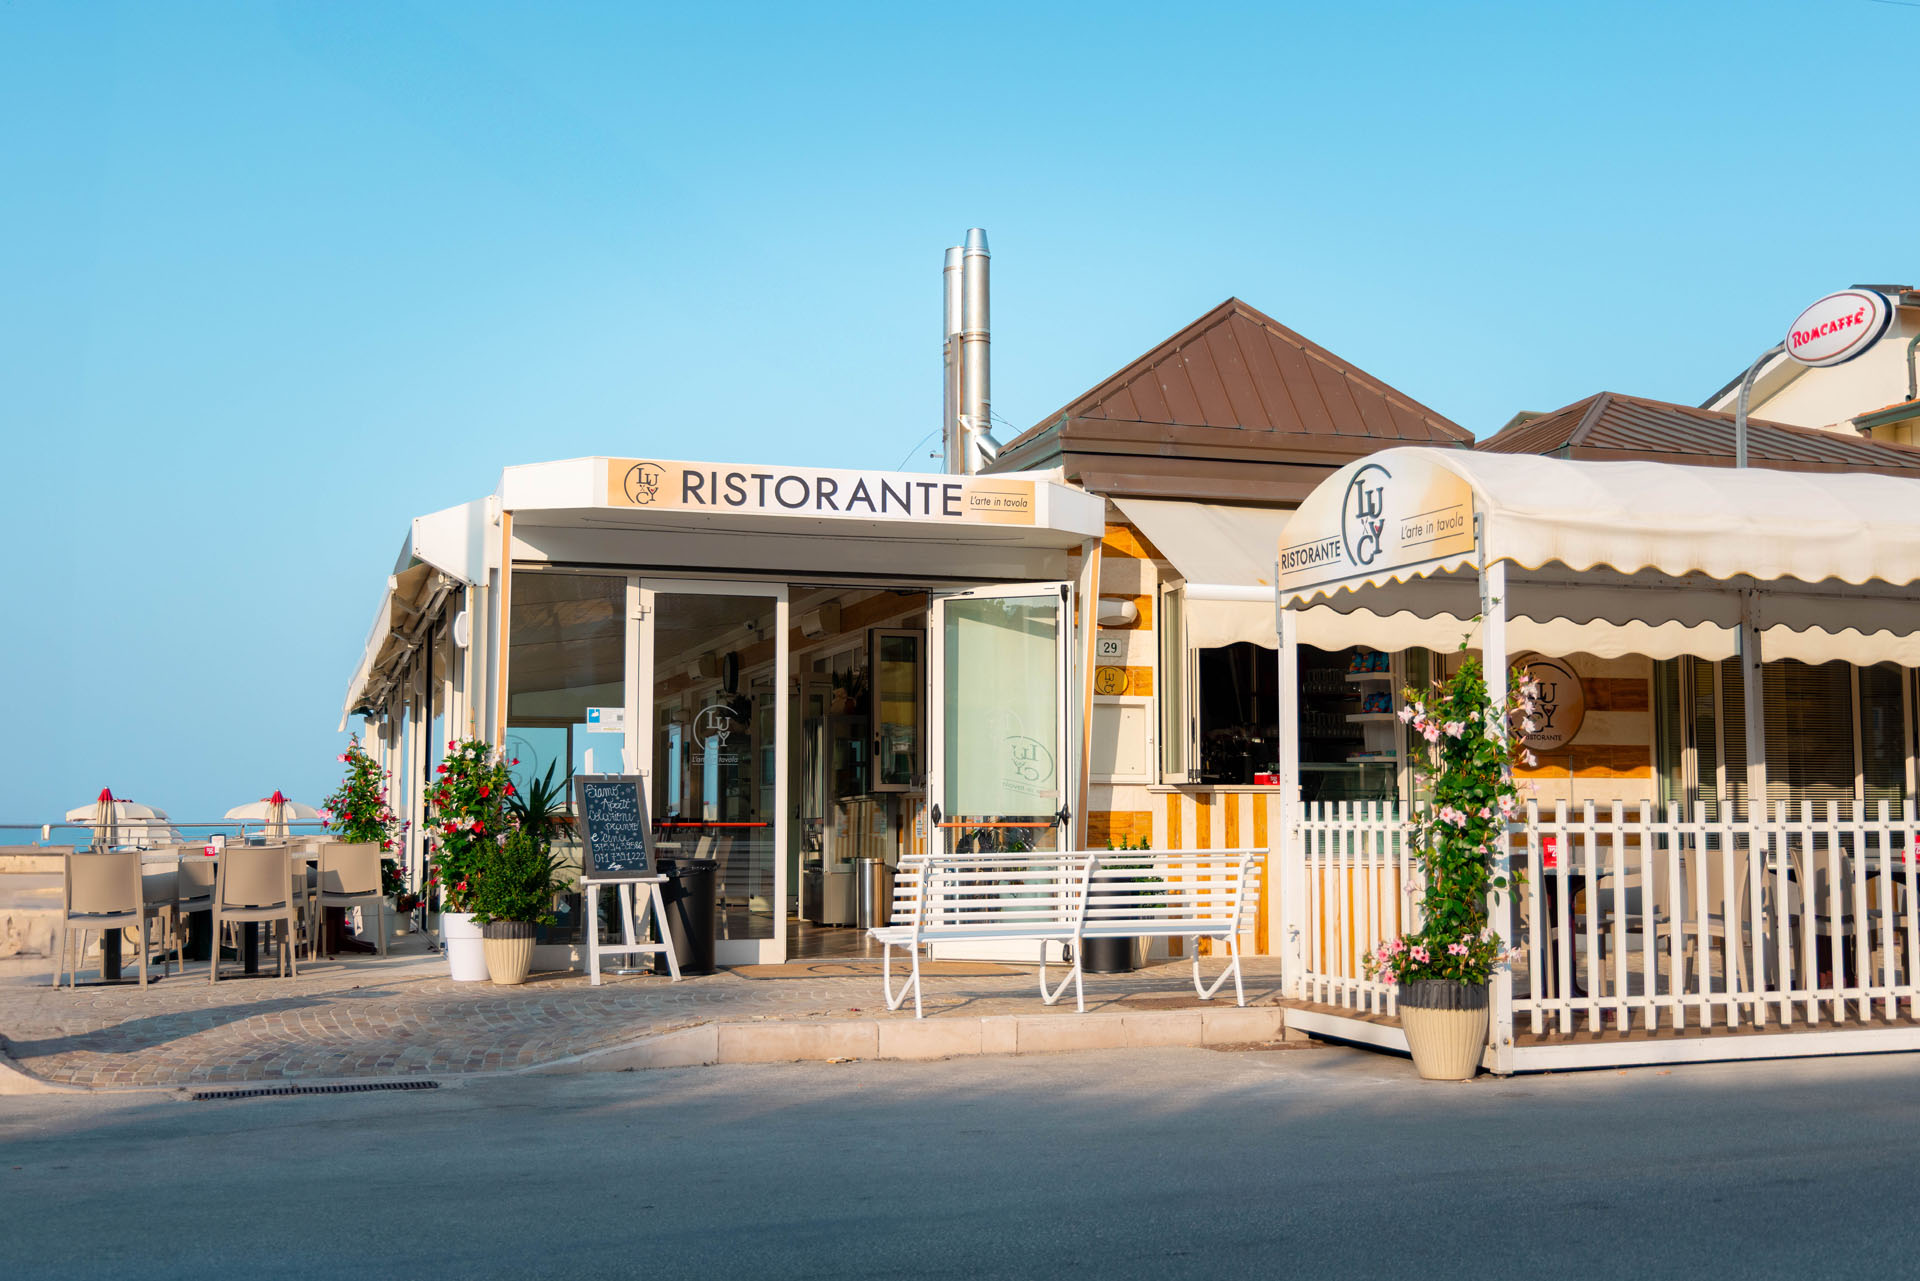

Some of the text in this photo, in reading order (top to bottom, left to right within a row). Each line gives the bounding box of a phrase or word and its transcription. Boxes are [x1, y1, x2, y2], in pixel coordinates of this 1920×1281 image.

[682, 469, 963, 517] RISTORANTE
[970, 495, 1028, 508] L'arte in tavola
[1401, 512, 1464, 540] L'arte in tavola
[1281, 540, 1341, 570] RISTORANTE
[1103, 642, 1118, 653] 29
[585, 784, 621, 798] Siamo
[591, 832, 599, 842] e
